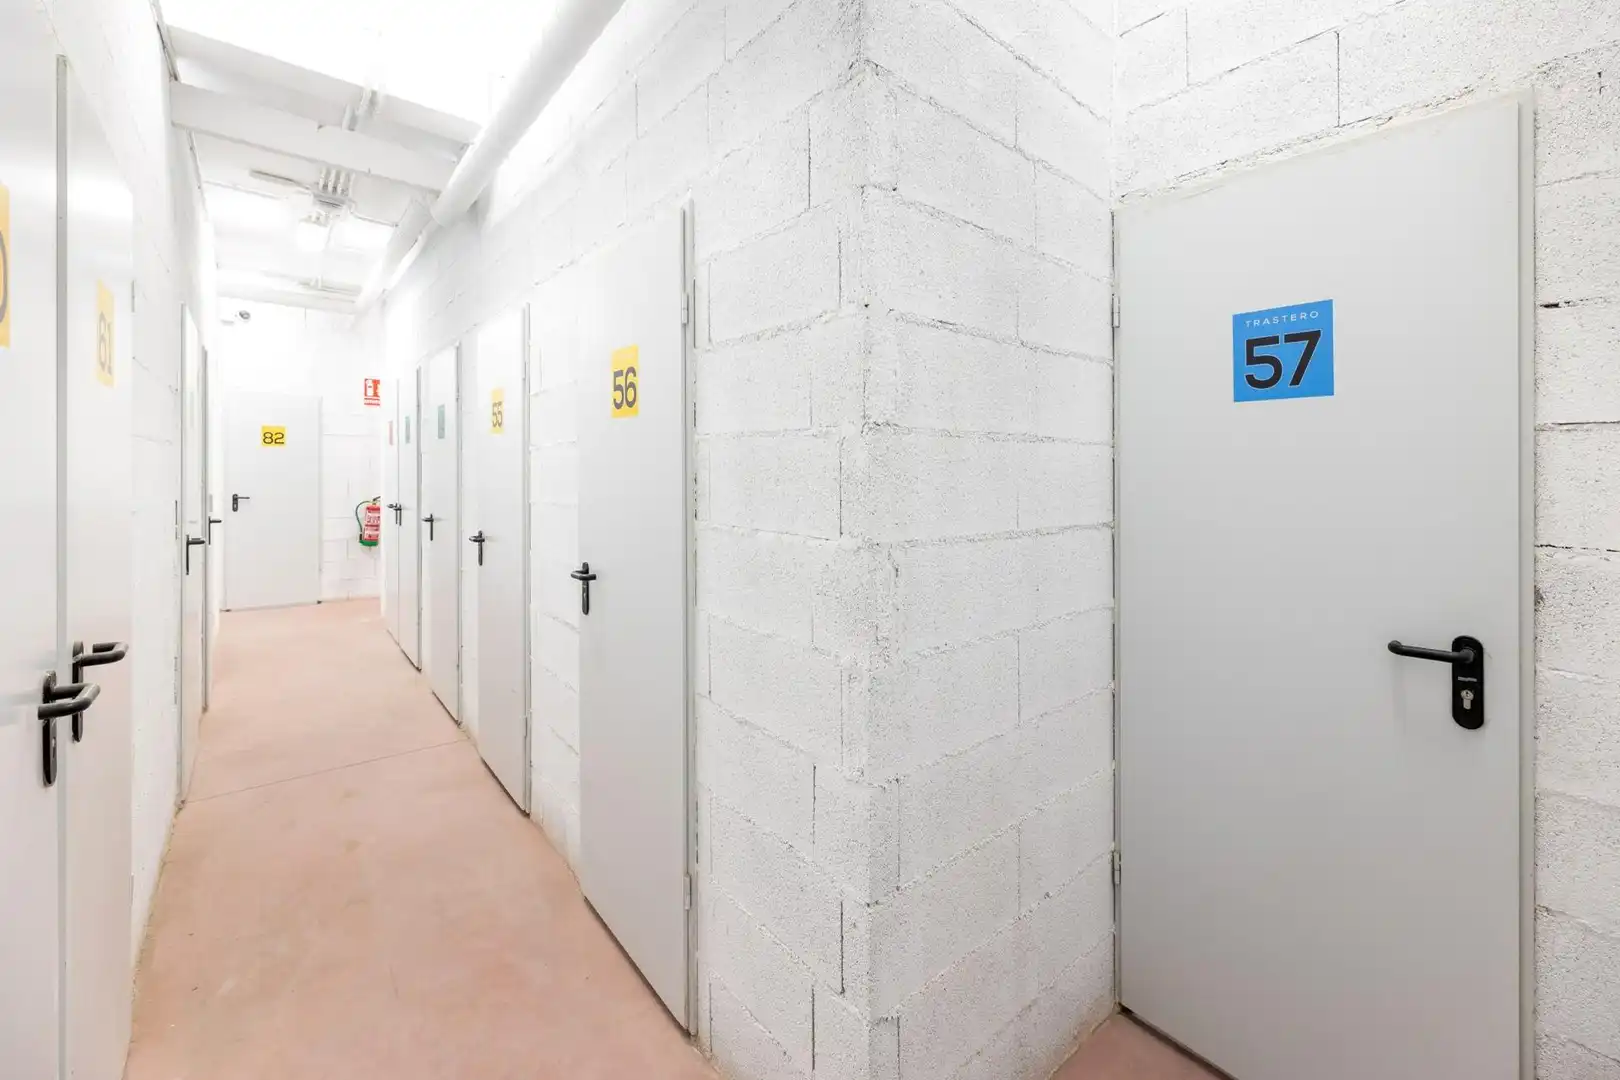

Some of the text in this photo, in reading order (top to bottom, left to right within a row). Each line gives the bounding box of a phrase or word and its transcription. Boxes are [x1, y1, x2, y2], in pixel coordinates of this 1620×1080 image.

[1244, 310, 1319, 328] TRASTERO
[98, 311, 113, 375] 61
[1245, 329, 1322, 389] 57
[613, 366, 637, 410] 56
[492, 400, 503, 428] 55
[262, 431, 285, 445] 82
